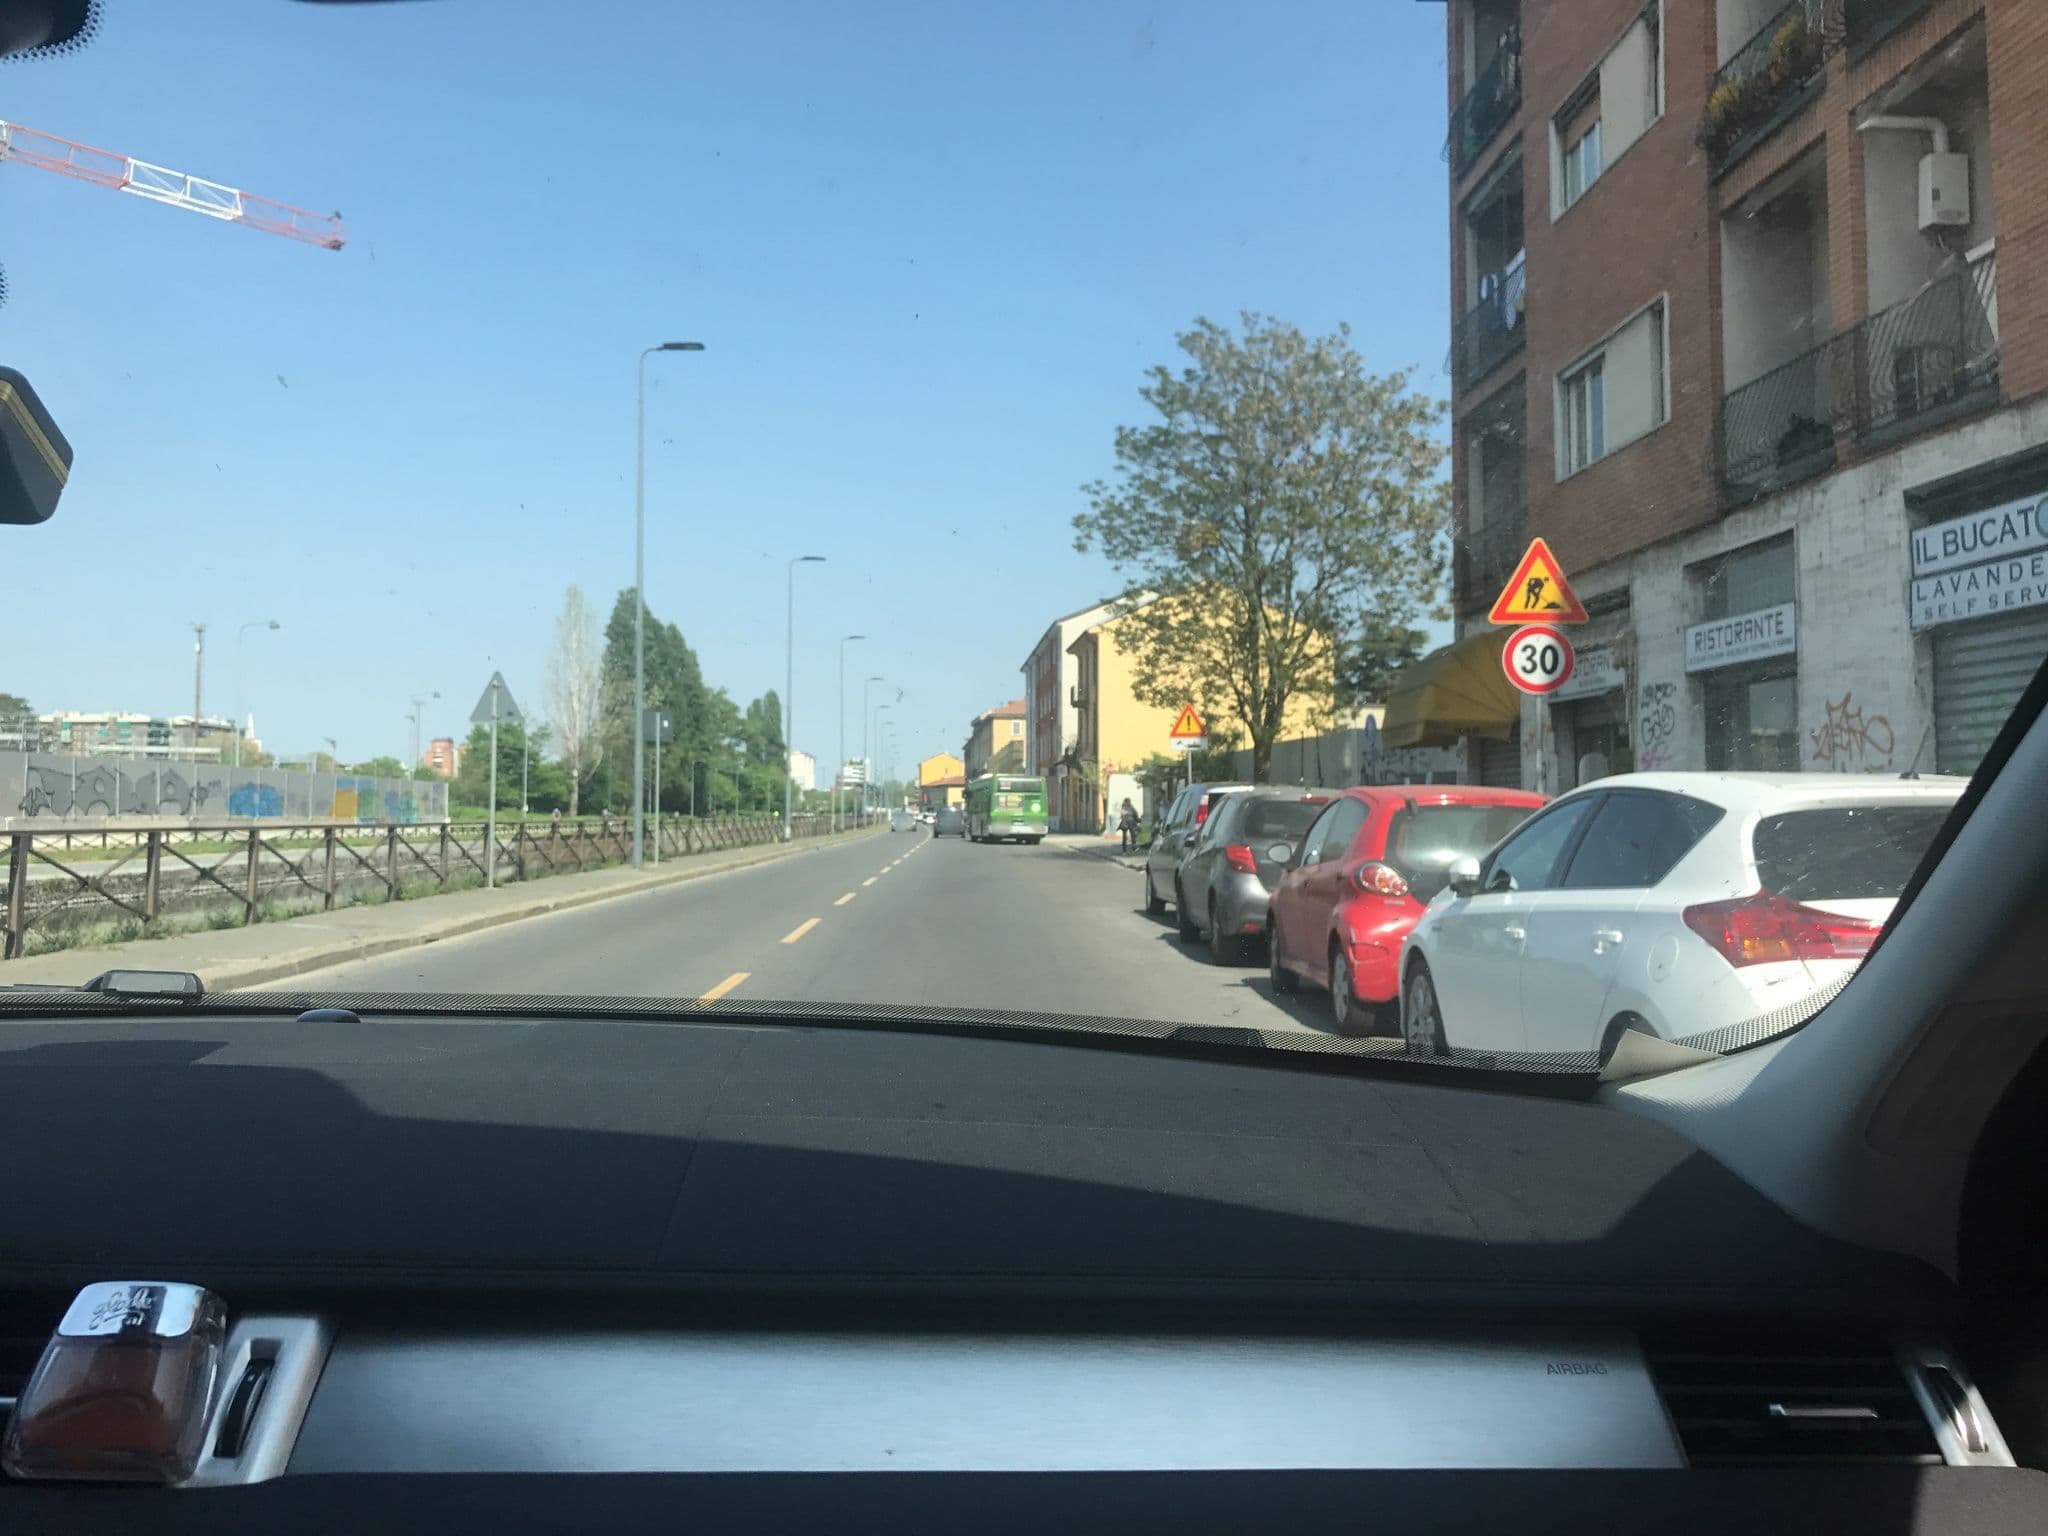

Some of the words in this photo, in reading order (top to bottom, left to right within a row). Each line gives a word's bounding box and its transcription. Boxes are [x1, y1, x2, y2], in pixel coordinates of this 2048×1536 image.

[1914, 536, 1938, 565] IL
[1915, 556, 2045, 603] LAVANDE
[1924, 597, 1977, 621] SELF
[1694, 611, 1784, 653] RISTORANTE
[1520, 644, 1559, 675] 30
[1546, 1363, 1608, 1376] AIRBAG
